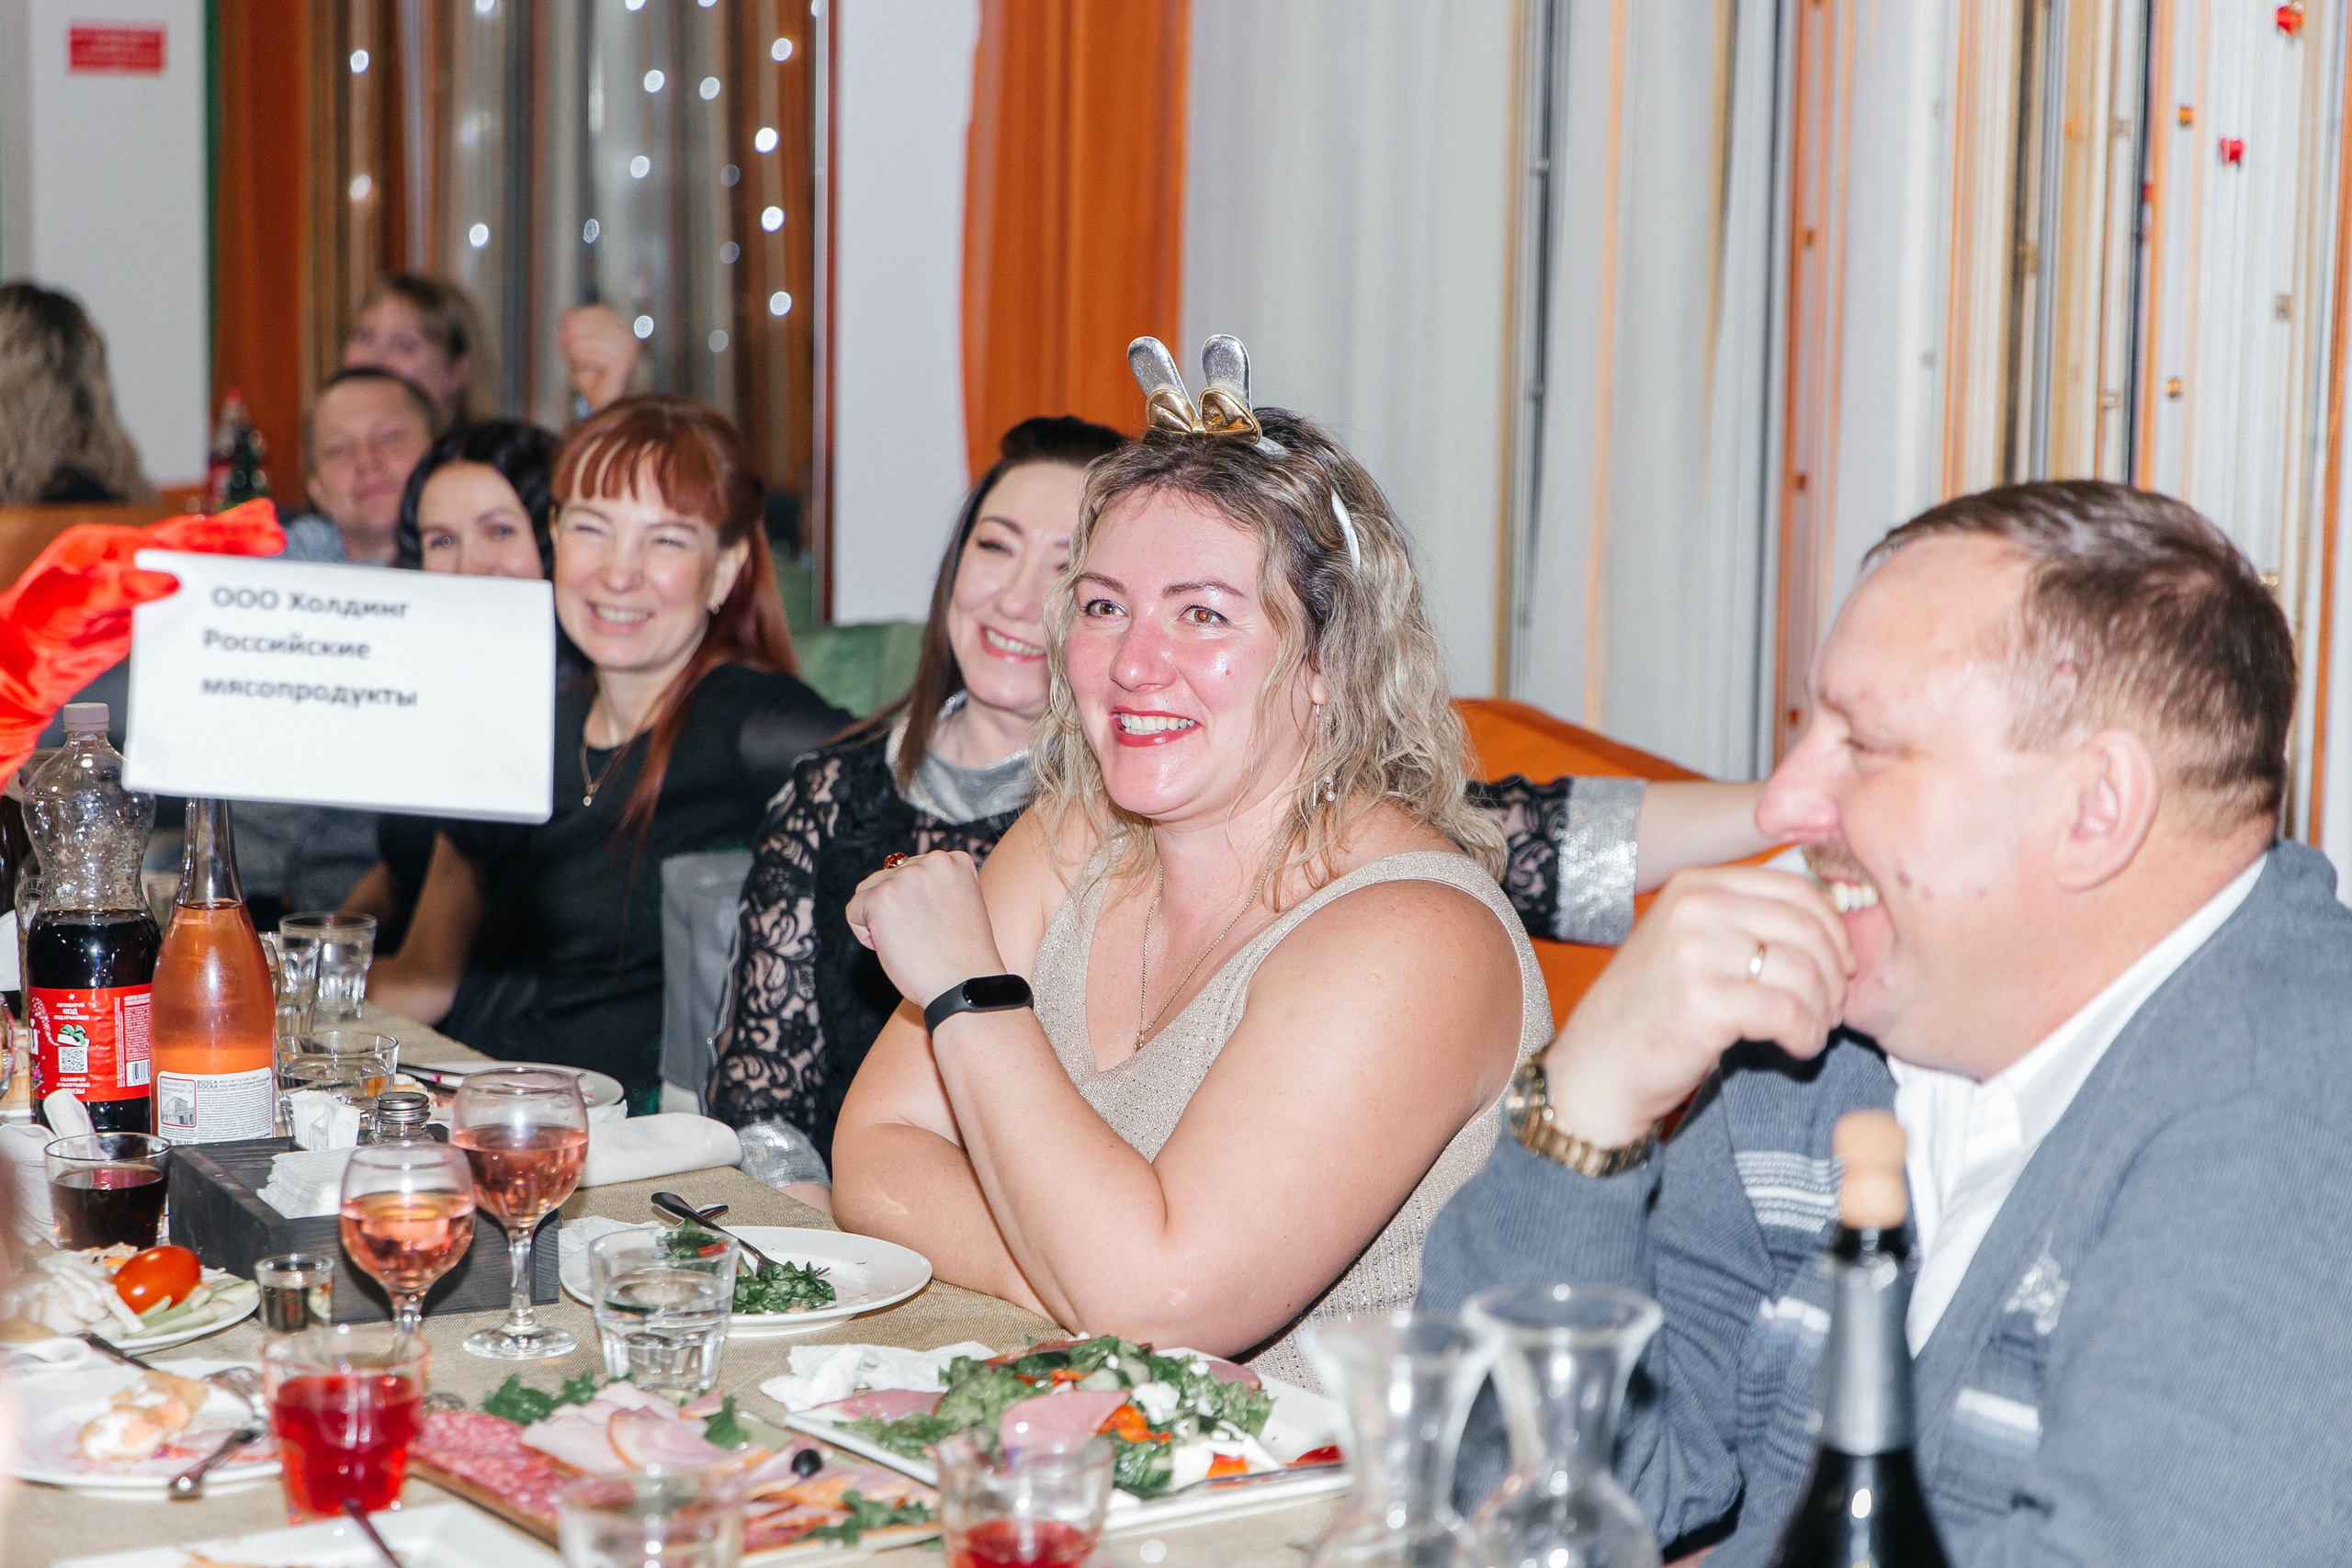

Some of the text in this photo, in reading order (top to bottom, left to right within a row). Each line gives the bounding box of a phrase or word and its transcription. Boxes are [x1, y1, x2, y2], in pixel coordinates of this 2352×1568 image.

[212, 587, 410, 618] ООО Холдинг
[204, 630, 370, 659] Российские
[203, 679, 417, 707] мясопродукты
